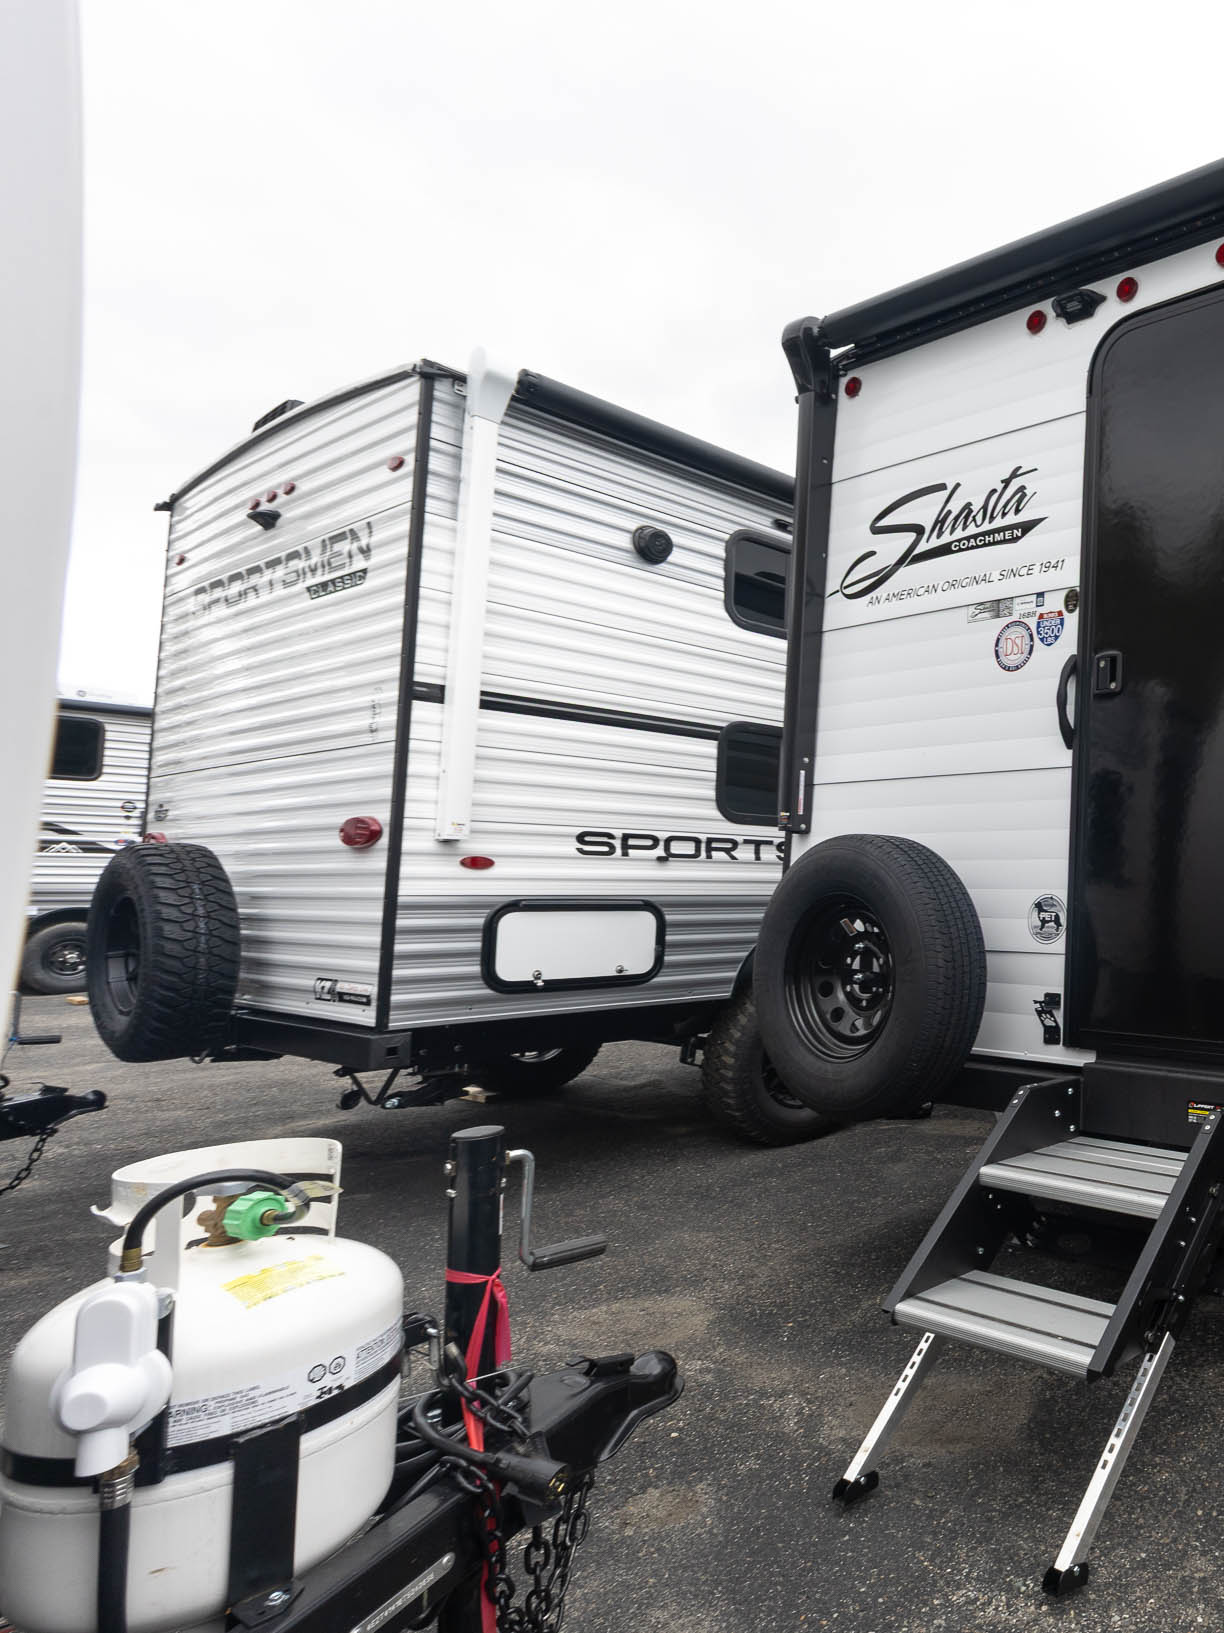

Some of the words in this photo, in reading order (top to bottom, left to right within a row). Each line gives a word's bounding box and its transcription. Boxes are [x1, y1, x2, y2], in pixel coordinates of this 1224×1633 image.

[840, 465, 1038, 600] Shasta
[950, 527, 1022, 551] COACHMEN
[193, 520, 373, 616] SPORTSMEN
[310, 571, 367, 599] CLASSIC
[866, 594, 882, 608] AN
[883, 582, 940, 604] AMERICAN
[941, 572, 995, 593] ORIGINAL
[997, 563, 1037, 582] SINCE
[1038, 558, 1066, 574] 1941
[1038, 624, 1062, 639] 3500
[1040, 619, 1061, 628] UNDER
[1004, 635, 1025, 657] DSI
[575, 830, 785, 862] SPORT
[1039, 912, 1057, 921] PET
